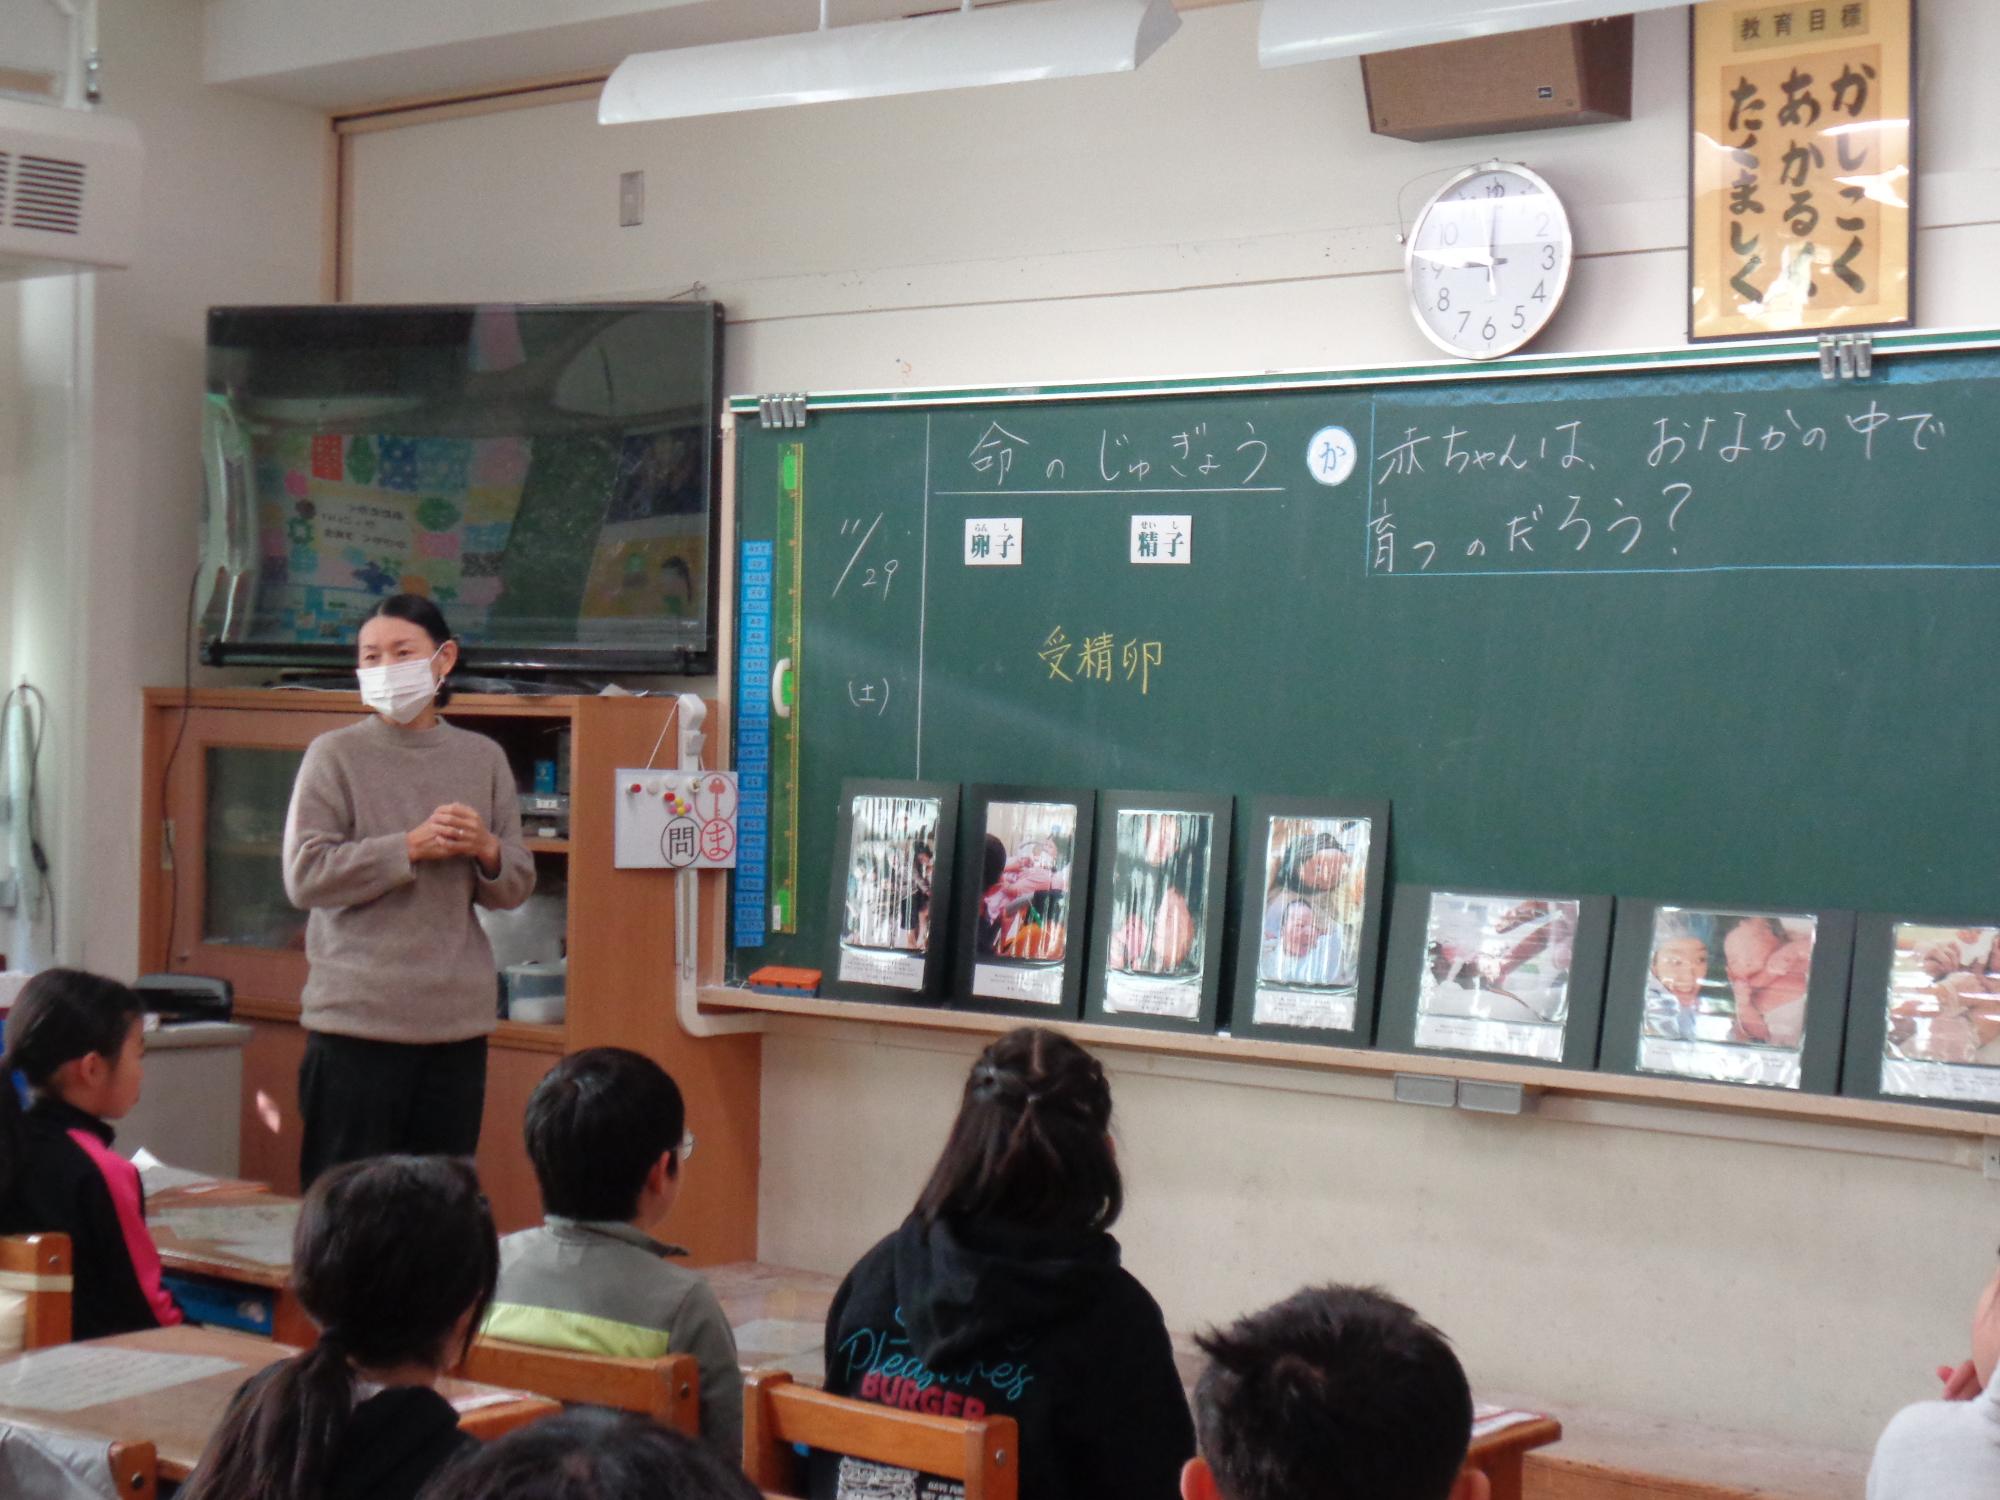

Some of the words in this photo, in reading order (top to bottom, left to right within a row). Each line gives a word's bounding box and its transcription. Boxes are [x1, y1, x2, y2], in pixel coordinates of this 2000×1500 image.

[1741, 2, 1862, 41] 教育目標
[1728, 76, 1766, 304] たくましく
[1831, 62, 1876, 294] かしこく
[1541, 244, 1556, 270] 3
[1436, 286, 1450, 312] 8
[1531, 279, 1546, 303] 4
[1458, 310, 1471, 333] 7
[1481, 315, 1496, 341] 6
[1511, 304, 1525, 329] 5
[1319, 441, 1346, 475] か
[971, 533, 1016, 559] 卵子
[1138, 531, 1184, 558] 精子
[1038, 625, 1162, 695] 受精卵
[848, 677, 890, 716] (土)
[668, 825, 696, 861] 問
[705, 822, 734, 857] ま
